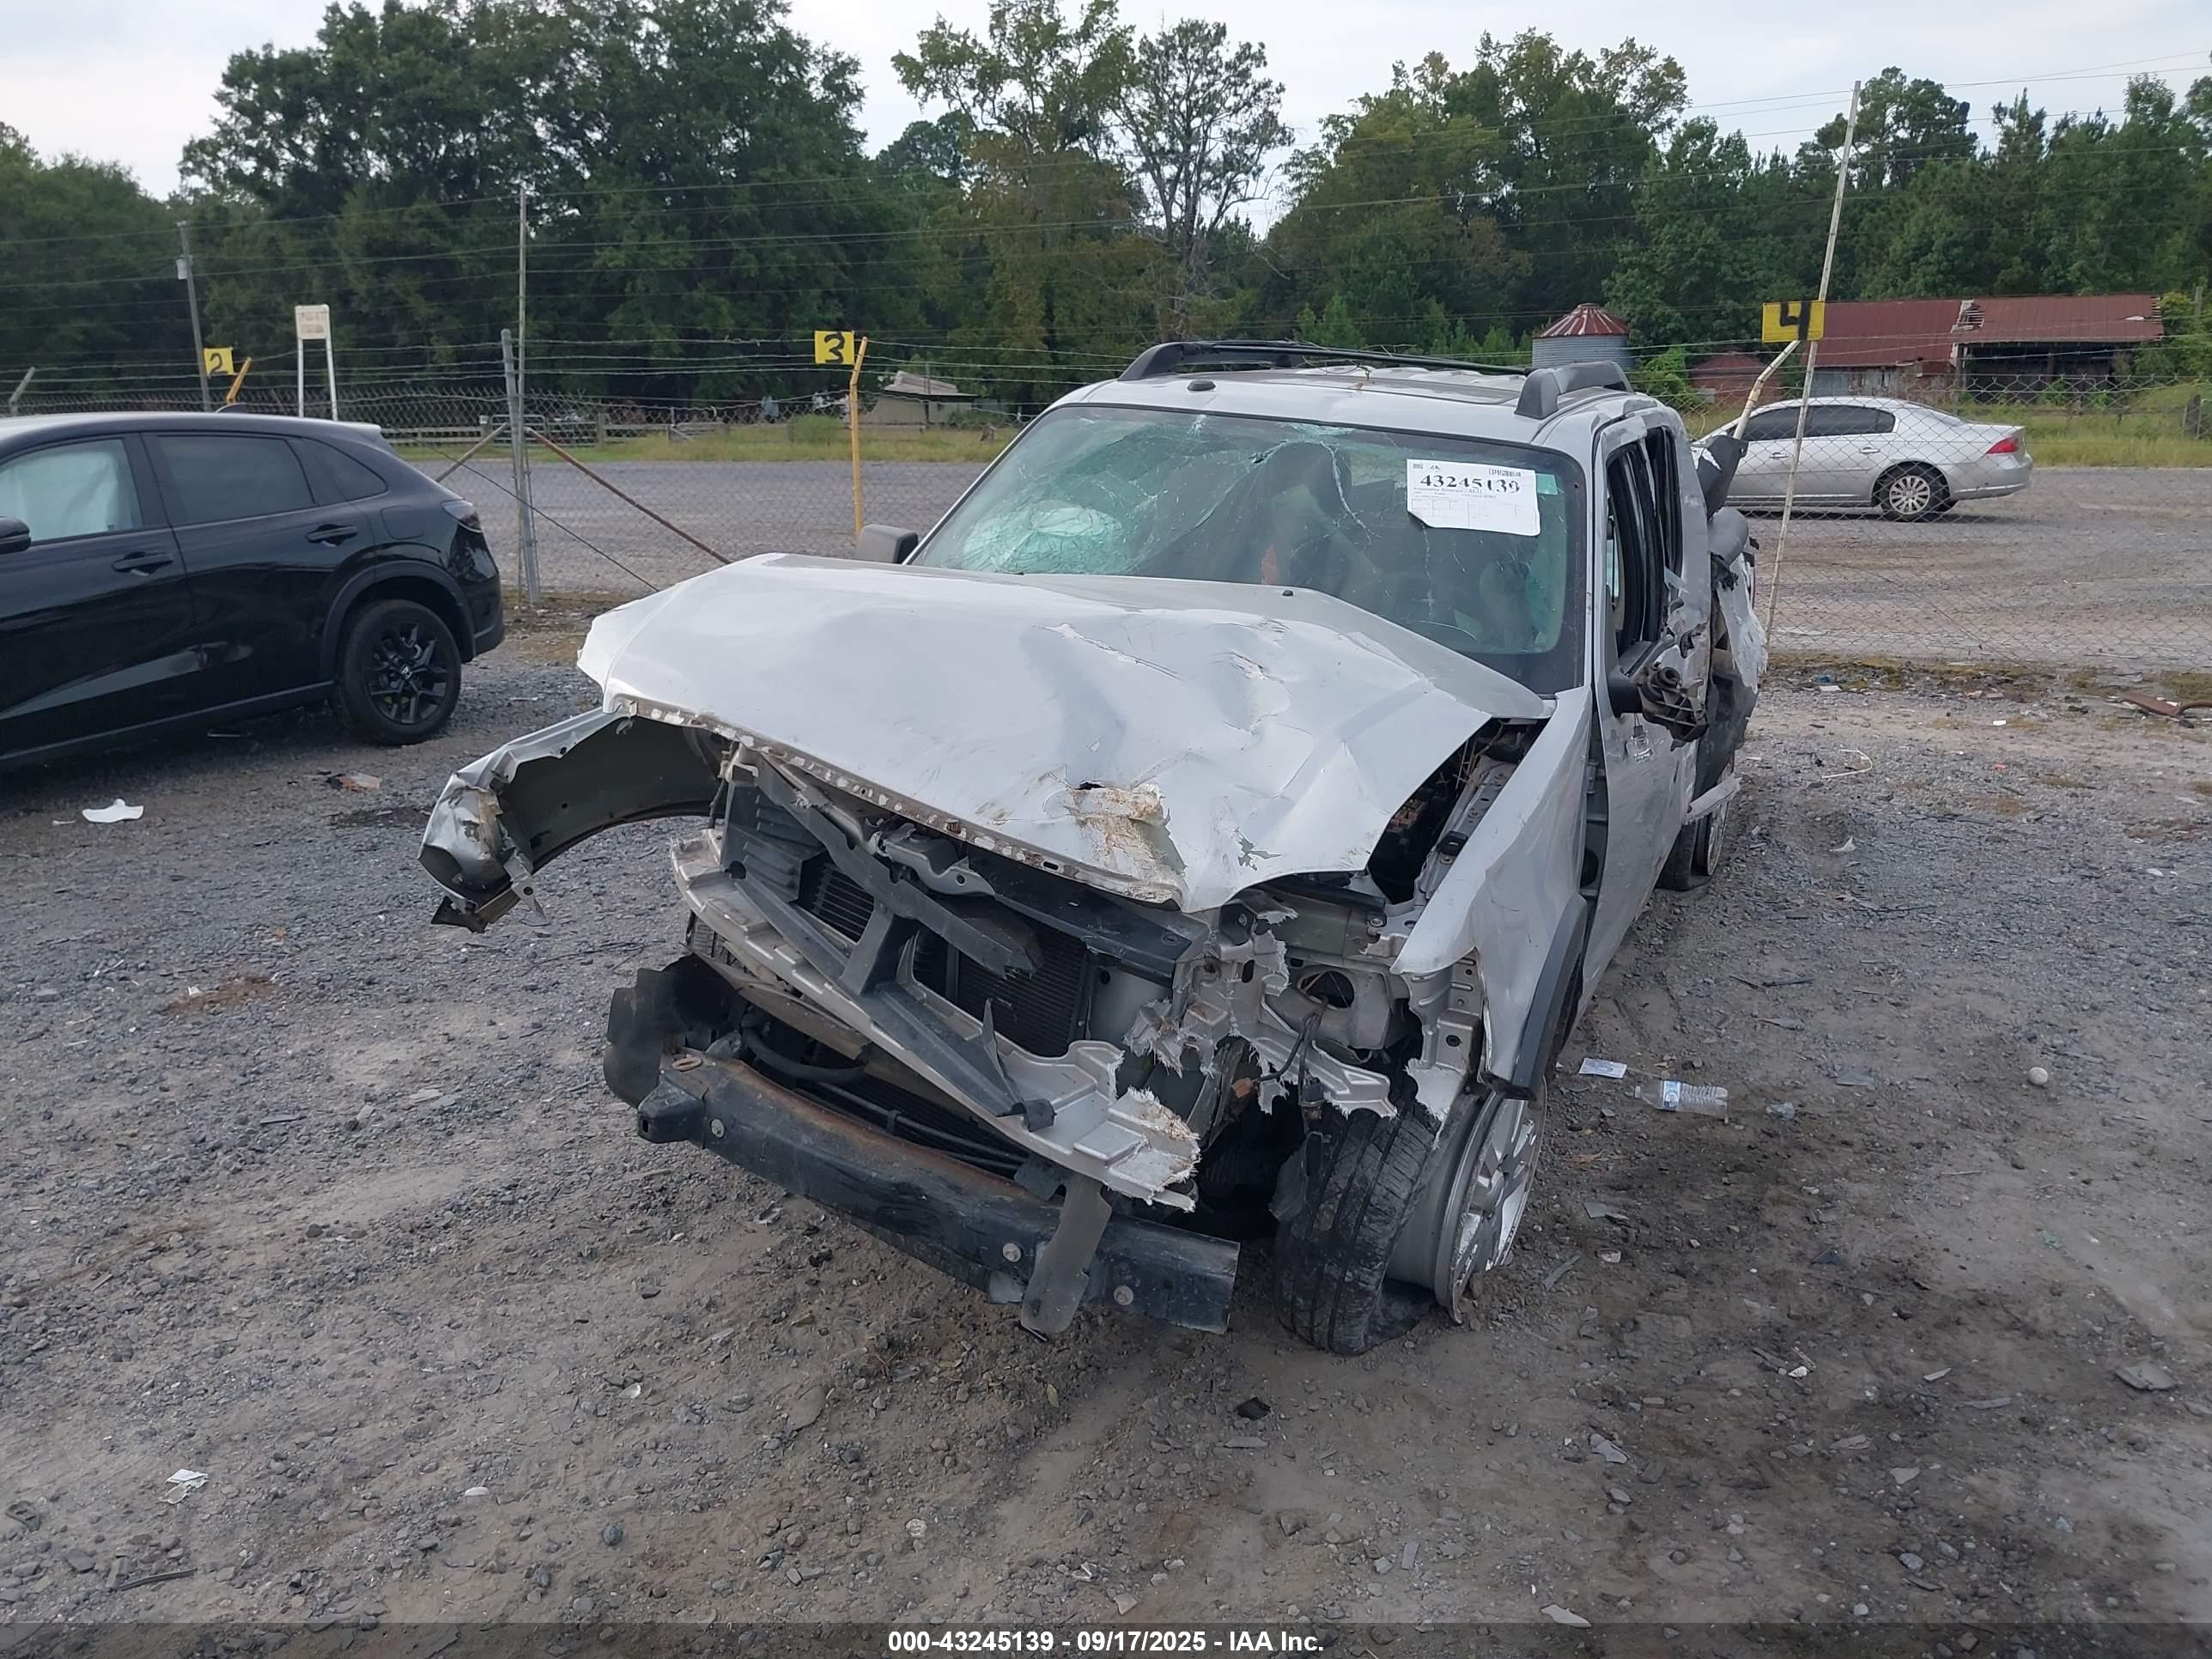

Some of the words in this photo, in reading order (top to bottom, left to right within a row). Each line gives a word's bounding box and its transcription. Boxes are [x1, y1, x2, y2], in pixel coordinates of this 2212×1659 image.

[1780, 301, 1810, 341] 4
[824, 331, 845, 363] 3
[210, 352, 229, 376] 2
[1420, 474, 1520, 494] 43245139
